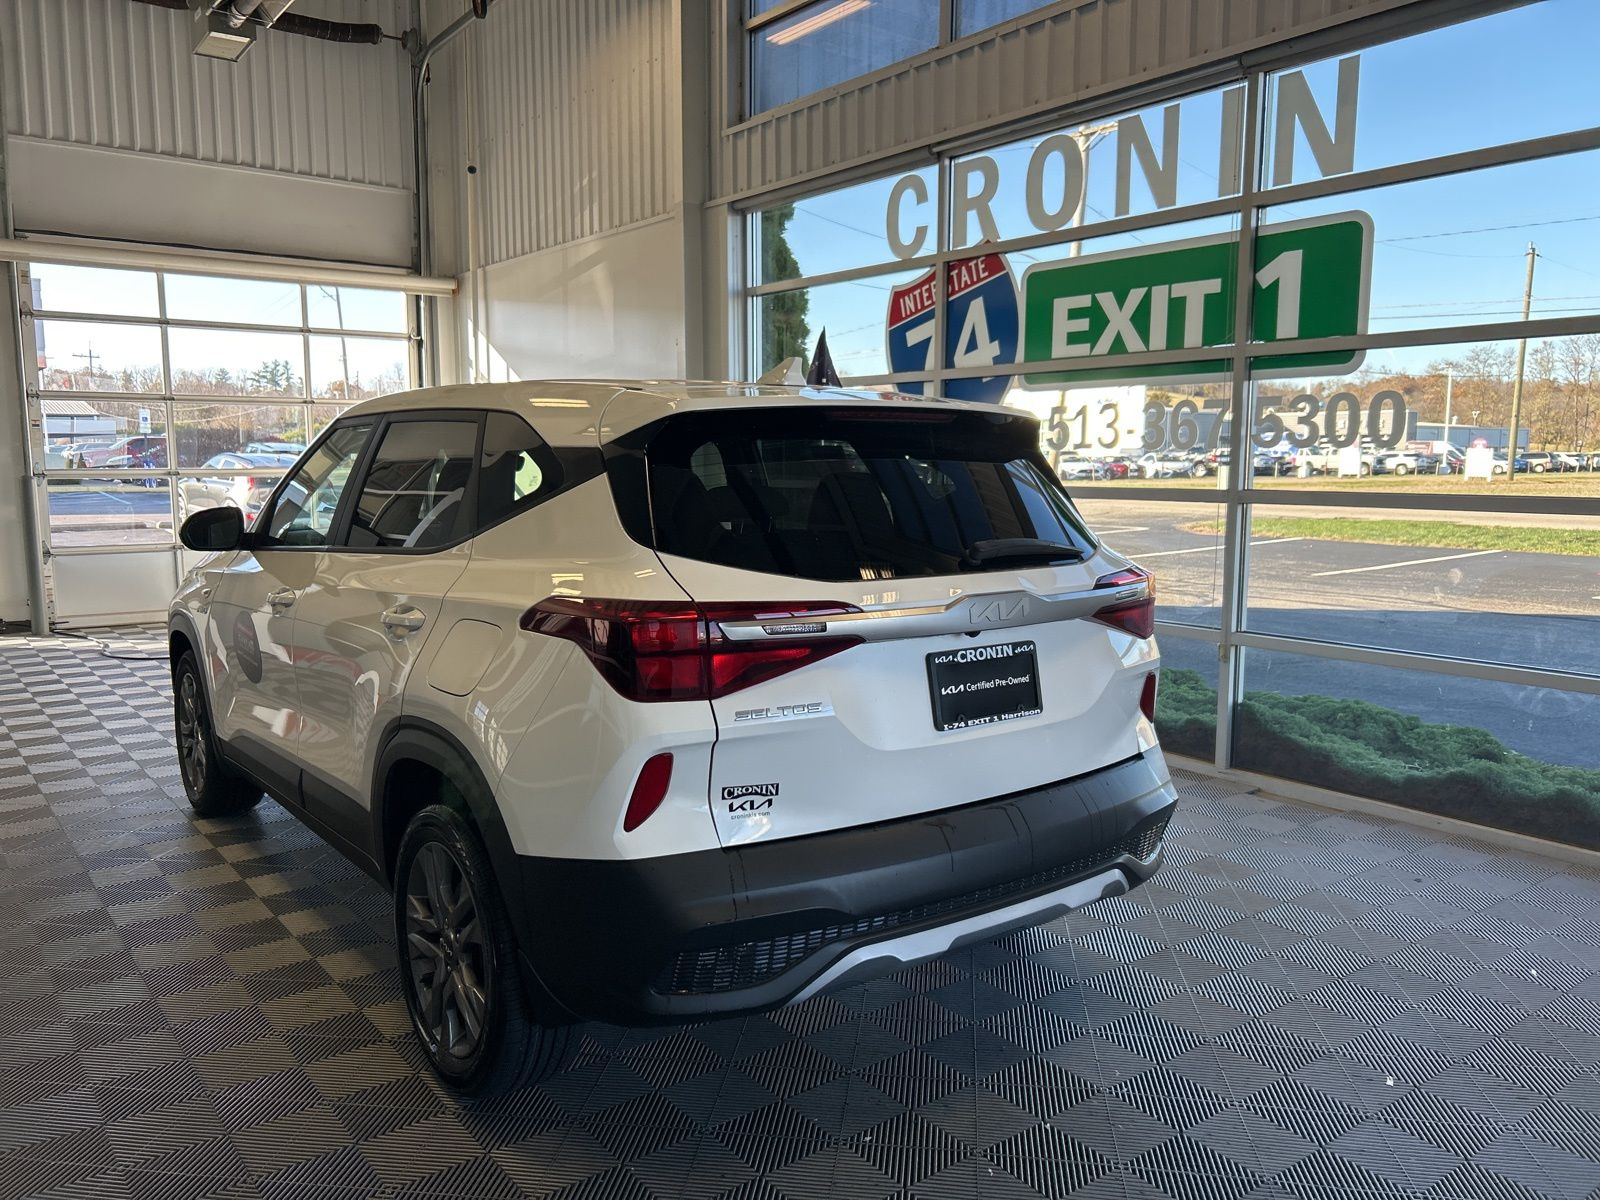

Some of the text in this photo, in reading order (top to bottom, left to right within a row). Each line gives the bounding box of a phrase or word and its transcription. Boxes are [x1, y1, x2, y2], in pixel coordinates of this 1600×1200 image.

[886, 54, 1361, 261] CRONIN
[900, 257, 989, 318] INTERTATE
[1051, 249, 1303, 359] EXIT 1
[906, 296, 1000, 398] 74
[1047, 390, 1407, 450] 513-3675300
[969, 597, 1031, 625] KIA
[957, 644, 1014, 663] CRONIN
[941, 675, 1030, 695] KIA Certified Pre-Owned
[734, 702, 822, 721] SELTOS
[943, 721, 966, 731] I-74
[968, 716, 991, 727] EXIT
[1001, 708, 1041, 720] Harrison
[723, 783, 778, 800] CRONIN
[728, 798, 773, 813] KIA
